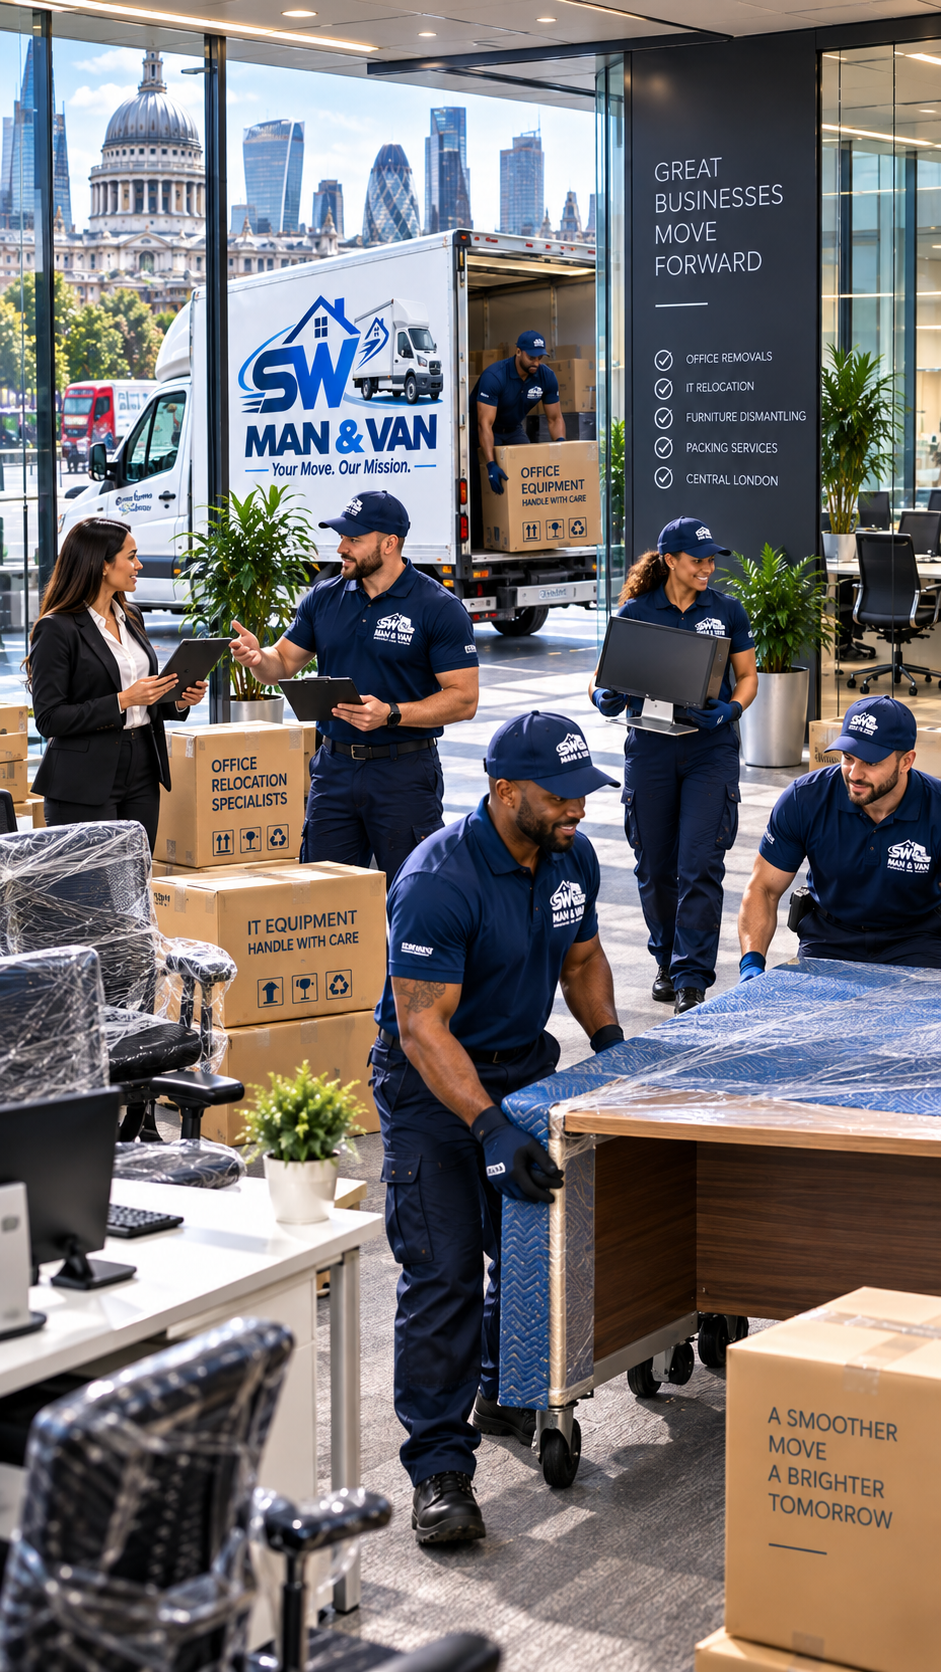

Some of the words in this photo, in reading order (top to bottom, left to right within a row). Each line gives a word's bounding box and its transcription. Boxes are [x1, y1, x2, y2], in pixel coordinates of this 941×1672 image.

[654, 157, 722, 182] GREAT
[655, 184, 784, 213] BUSINESSES
[655, 221, 717, 244] MOVE
[655, 251, 763, 276] FORWARD
[686, 353, 719, 365] OFFICE
[721, 351, 773, 364] REMOVALS
[252, 337, 360, 414] SW
[686, 383, 694, 393] IT
[696, 381, 755, 393] RELOCATION
[686, 412, 738, 423] FURNITURE
[740, 410, 807, 422] DISMANTLING
[245, 420, 330, 458] MAN
[335, 419, 365, 455] &
[365, 414, 438, 452] VAN
[686, 442, 729, 453] PACKING
[731, 442, 778, 454] SERVICES
[272, 462, 298, 477] Your
[300, 461, 335, 476] Move.
[338, 460, 361, 475] Our
[364, 458, 411, 474] Mission.
[520, 464, 560, 479] OFFICE
[521, 479, 585, 495] EQUIPMENT
[686, 473, 731, 486] CENTRAL
[733, 474, 779, 487] LONDON
[522, 496, 549, 507] HANDLE
[550, 495, 568, 505] WITH
[569, 494, 587, 503] CARE
[211, 756, 257, 773] OFFICE
[212, 773, 287, 792] RELOCATION
[212, 792, 287, 812] SPECIALISTS
[247, 920, 261, 935] IT
[266, 910, 357, 935] EQUIPMENT
[248, 938, 294, 955] HANDLE
[296, 935, 326, 950] WITH
[329, 931, 359, 946] CARE
[768, 1406, 781, 1425] A
[787, 1408, 898, 1442] SMOOTHER
[769, 1435, 827, 1461] MOVE
[768, 1464, 781, 1483] A
[788, 1466, 885, 1499] BRIGHTER
[768, 1492, 893, 1530] TOMORROW
